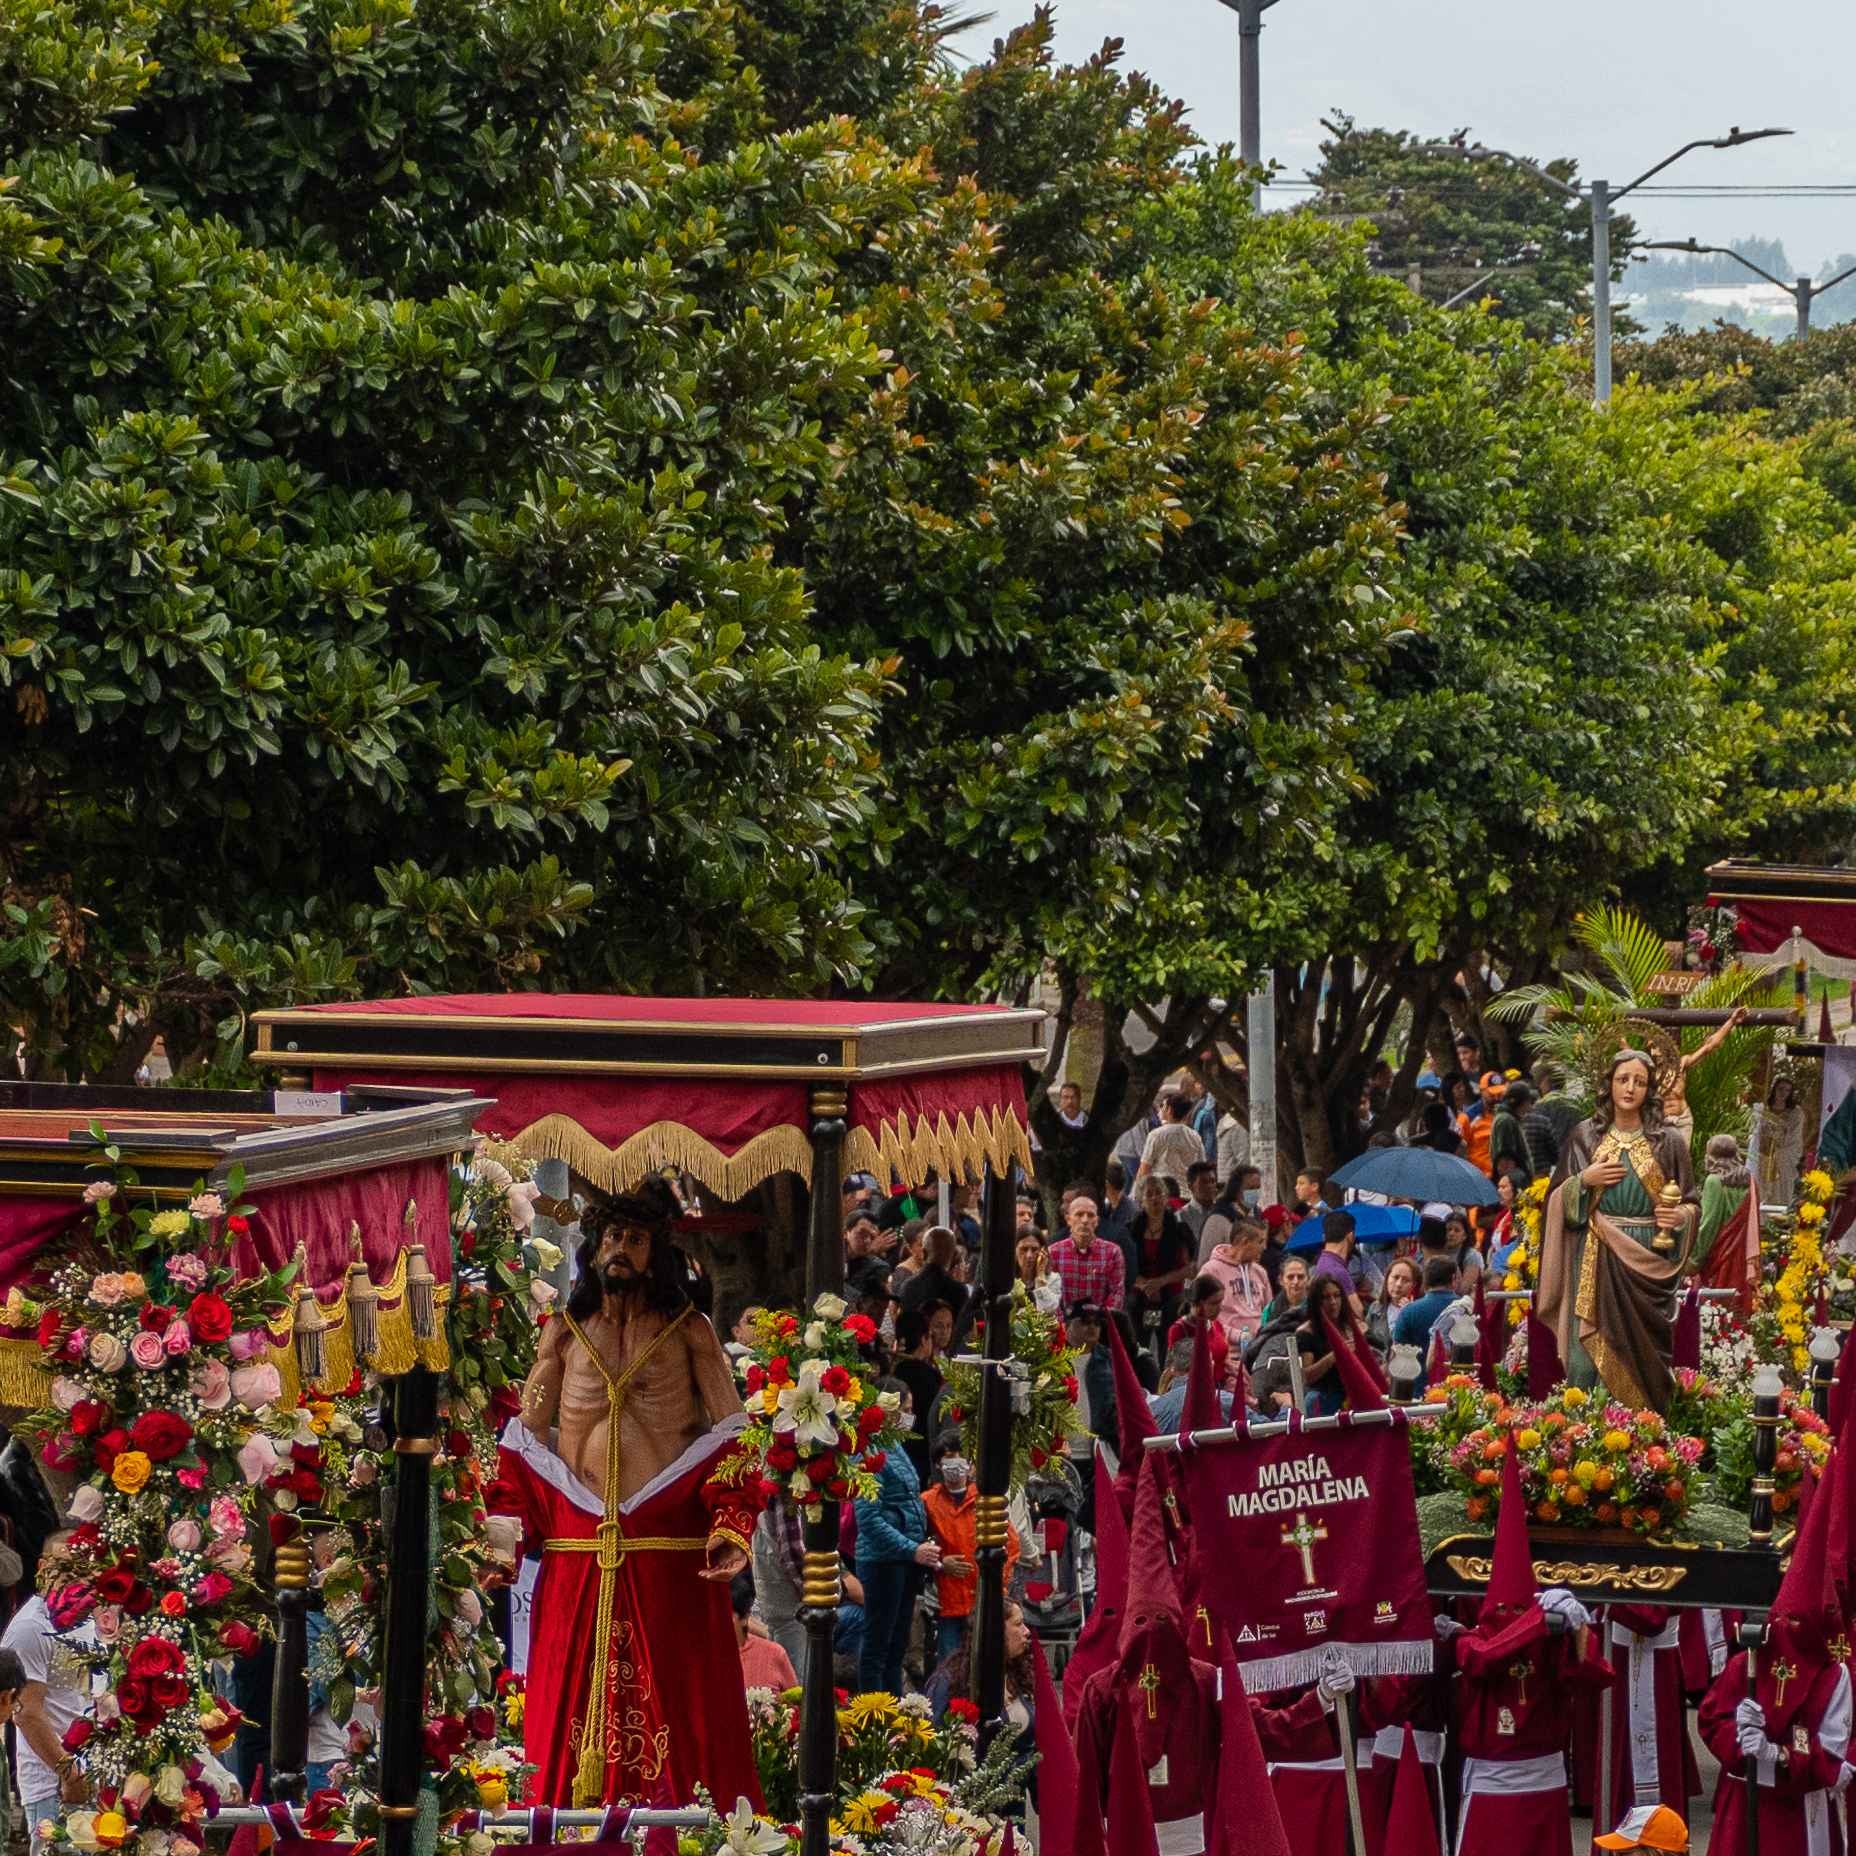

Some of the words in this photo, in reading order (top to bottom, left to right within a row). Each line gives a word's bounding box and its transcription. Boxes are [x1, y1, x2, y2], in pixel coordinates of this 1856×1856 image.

[1647, 974, 1695, 992] INRI
[1258, 1453, 1332, 1489] MARÍA
[1227, 1475, 1370, 1518] MAGDALENA
